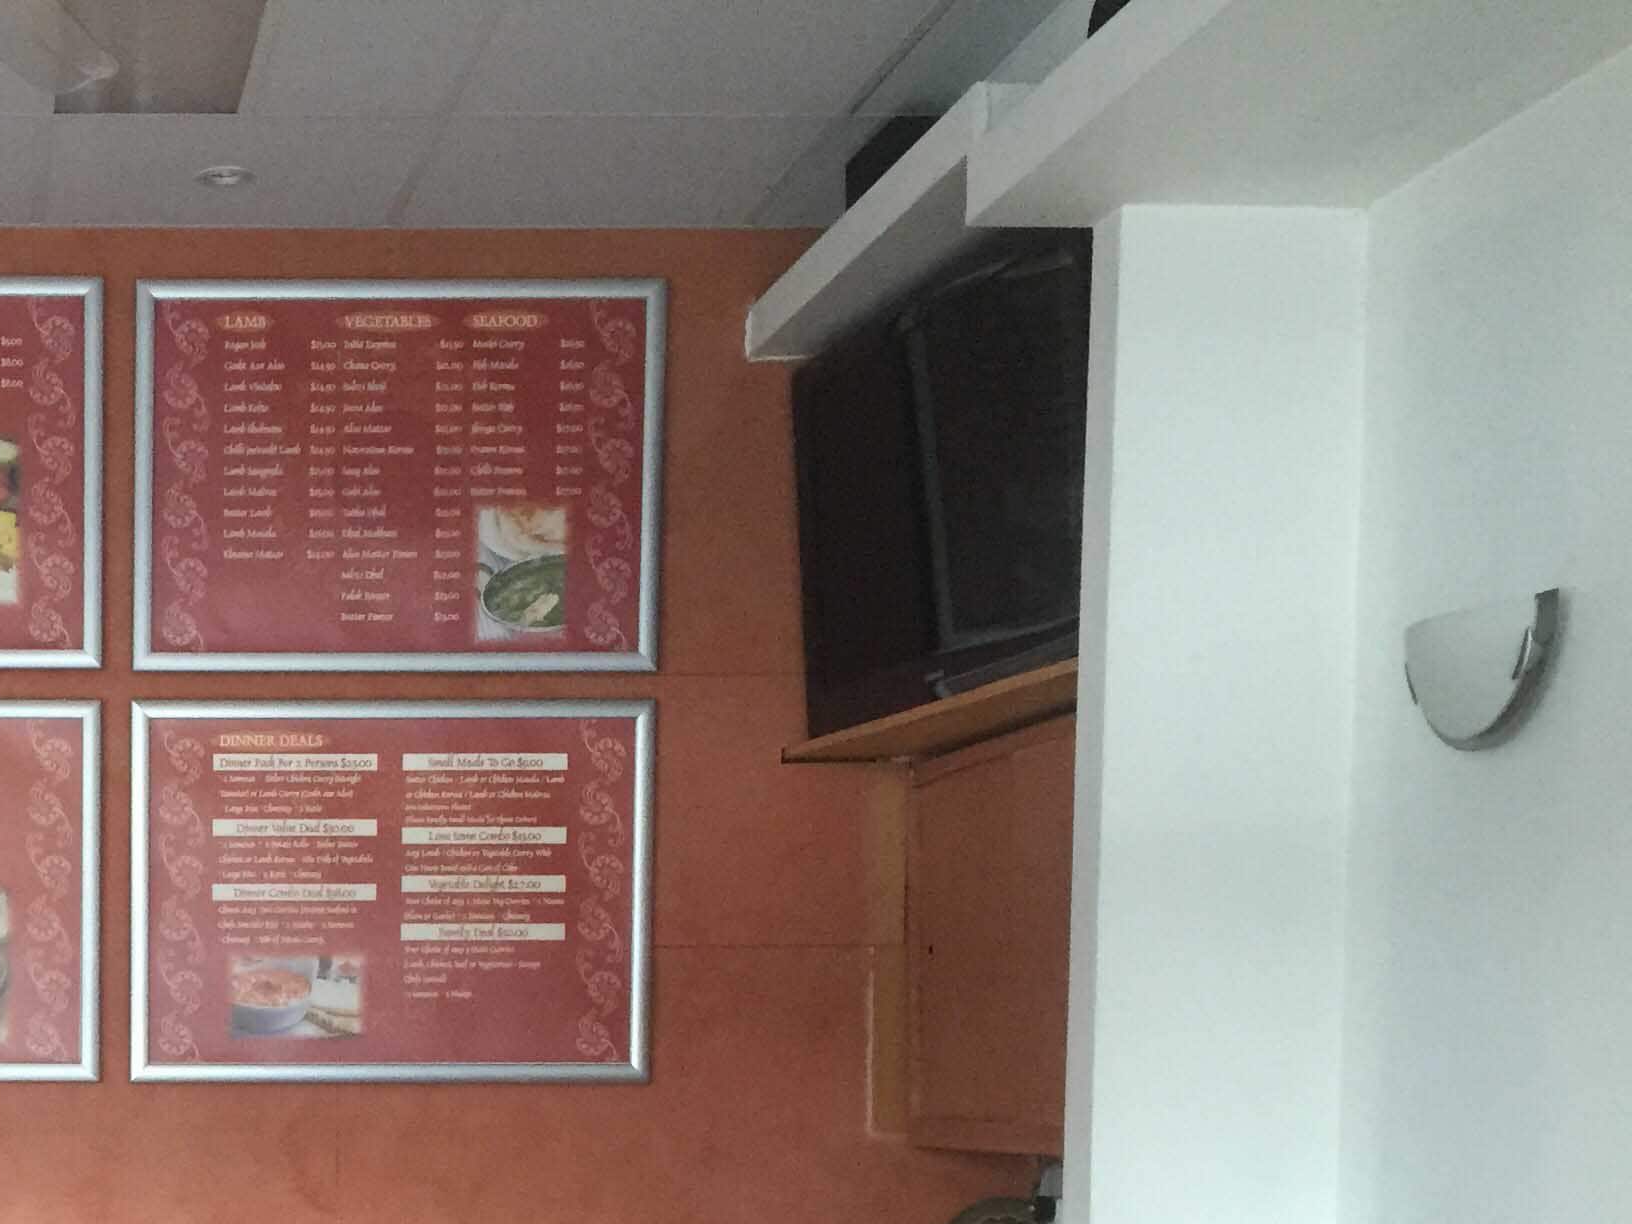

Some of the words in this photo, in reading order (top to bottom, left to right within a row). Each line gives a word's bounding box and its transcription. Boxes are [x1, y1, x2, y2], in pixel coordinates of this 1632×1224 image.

[224, 315, 267, 329] LAMB
[345, 315, 432, 328] VEGETABLES
[473, 315, 539, 328] SEAFOOD
[219, 734, 274, 747] DINNER
[279, 734, 323, 747] DEALS
[219, 757, 252, 769] Dinner
[277, 758, 294, 769] For
[304, 757, 339, 769] Persons
